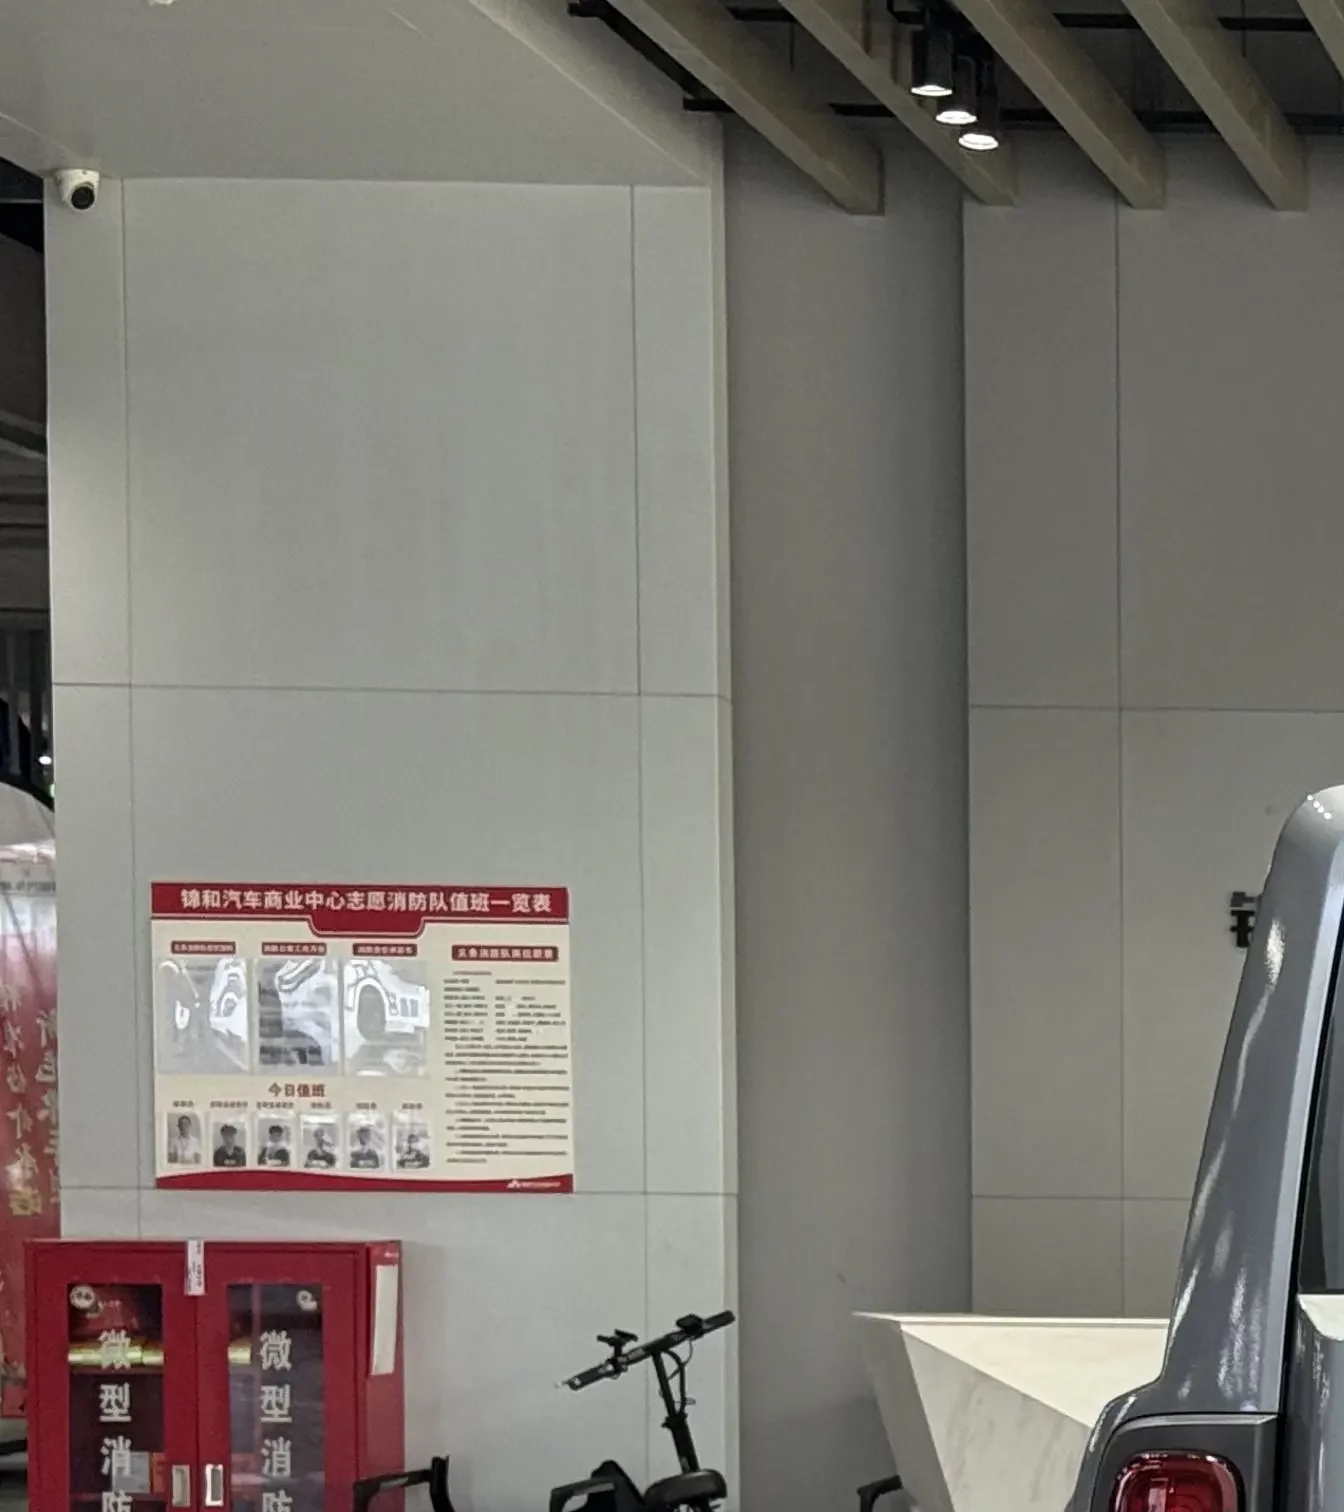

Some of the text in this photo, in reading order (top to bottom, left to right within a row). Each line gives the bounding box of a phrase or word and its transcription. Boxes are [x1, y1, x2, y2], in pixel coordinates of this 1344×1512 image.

[180, 887, 553, 914] 锦和汽车商业中心志愿消防队值班一览表
[267, 1081, 327, 1098] 今日值班
